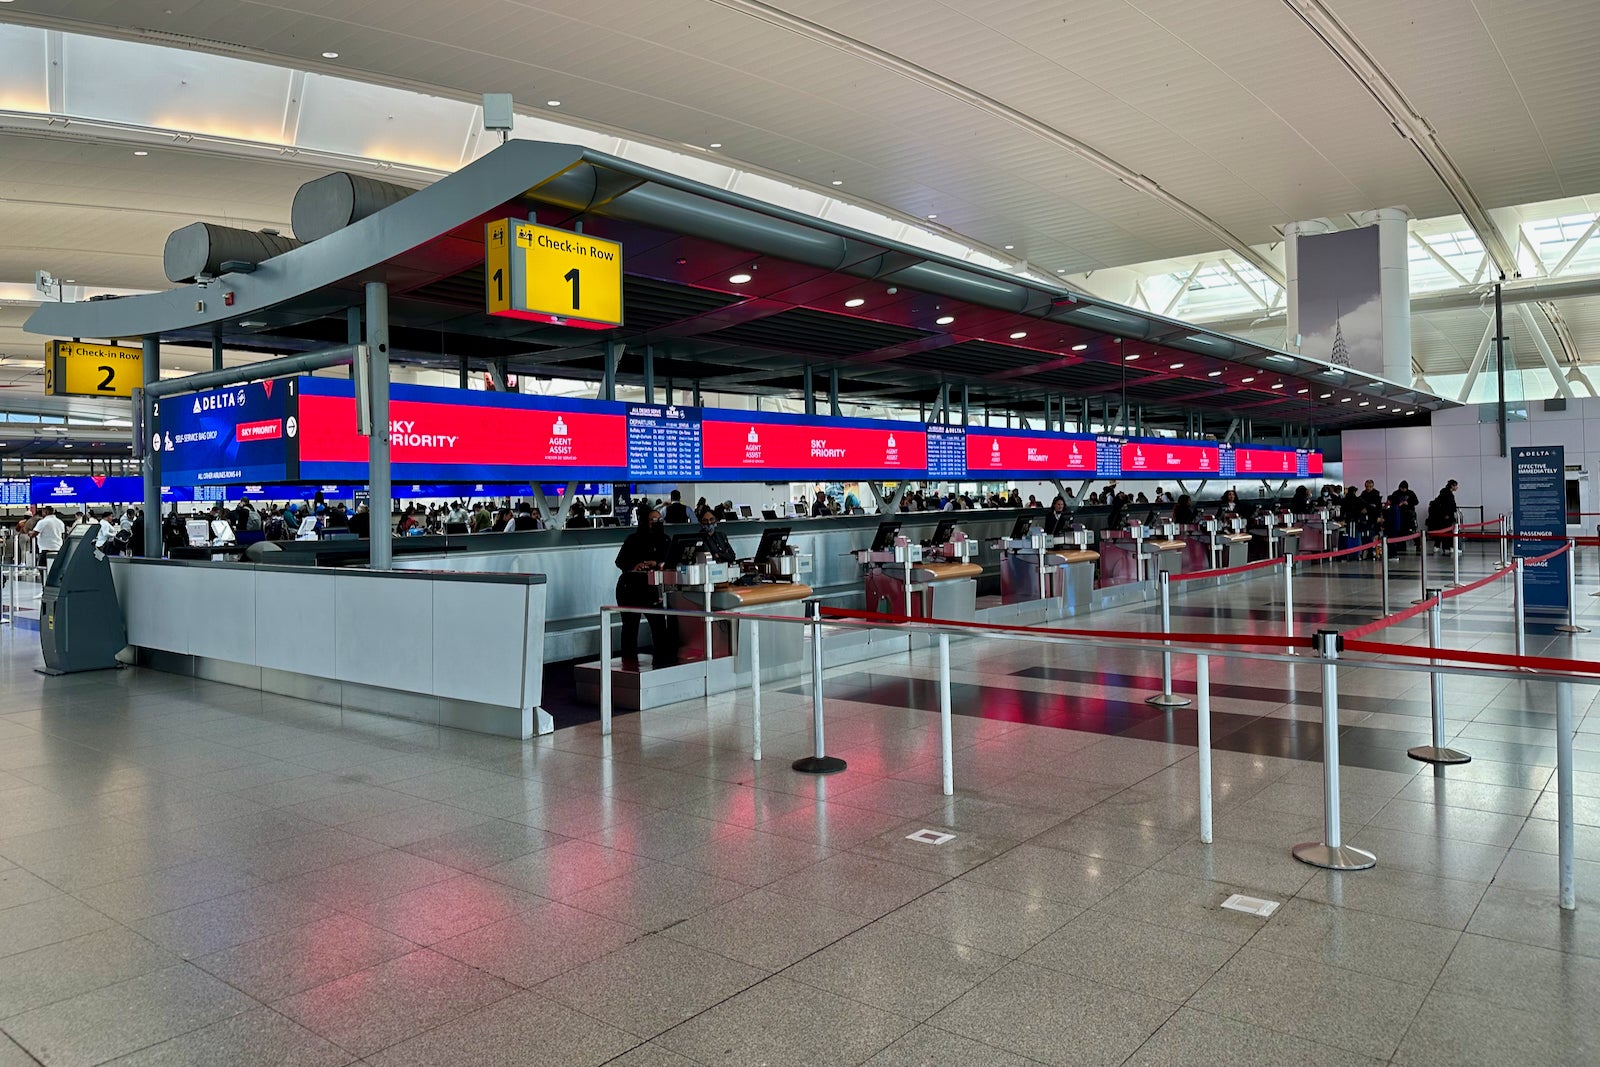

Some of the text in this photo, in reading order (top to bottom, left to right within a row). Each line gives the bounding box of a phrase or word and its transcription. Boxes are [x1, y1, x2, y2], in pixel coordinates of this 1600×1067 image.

[538, 235, 614, 262] Check-in Row
[493, 268, 503, 302] 1
[564, 268, 580, 310] 1
[76, 348, 140, 360] Check-in Row
[47, 369, 52, 388] 2
[97, 366, 116, 392] 2
[289, 381, 294, 396] 1
[202, 392, 235, 410] DELTA
[154, 403, 159, 416] 2
[241, 425, 277, 436] SKY PRIORITY
[389, 434, 456, 448] RIORITY
[811, 439, 826, 448] SKY
[811, 449, 846, 457] PRIORITY
